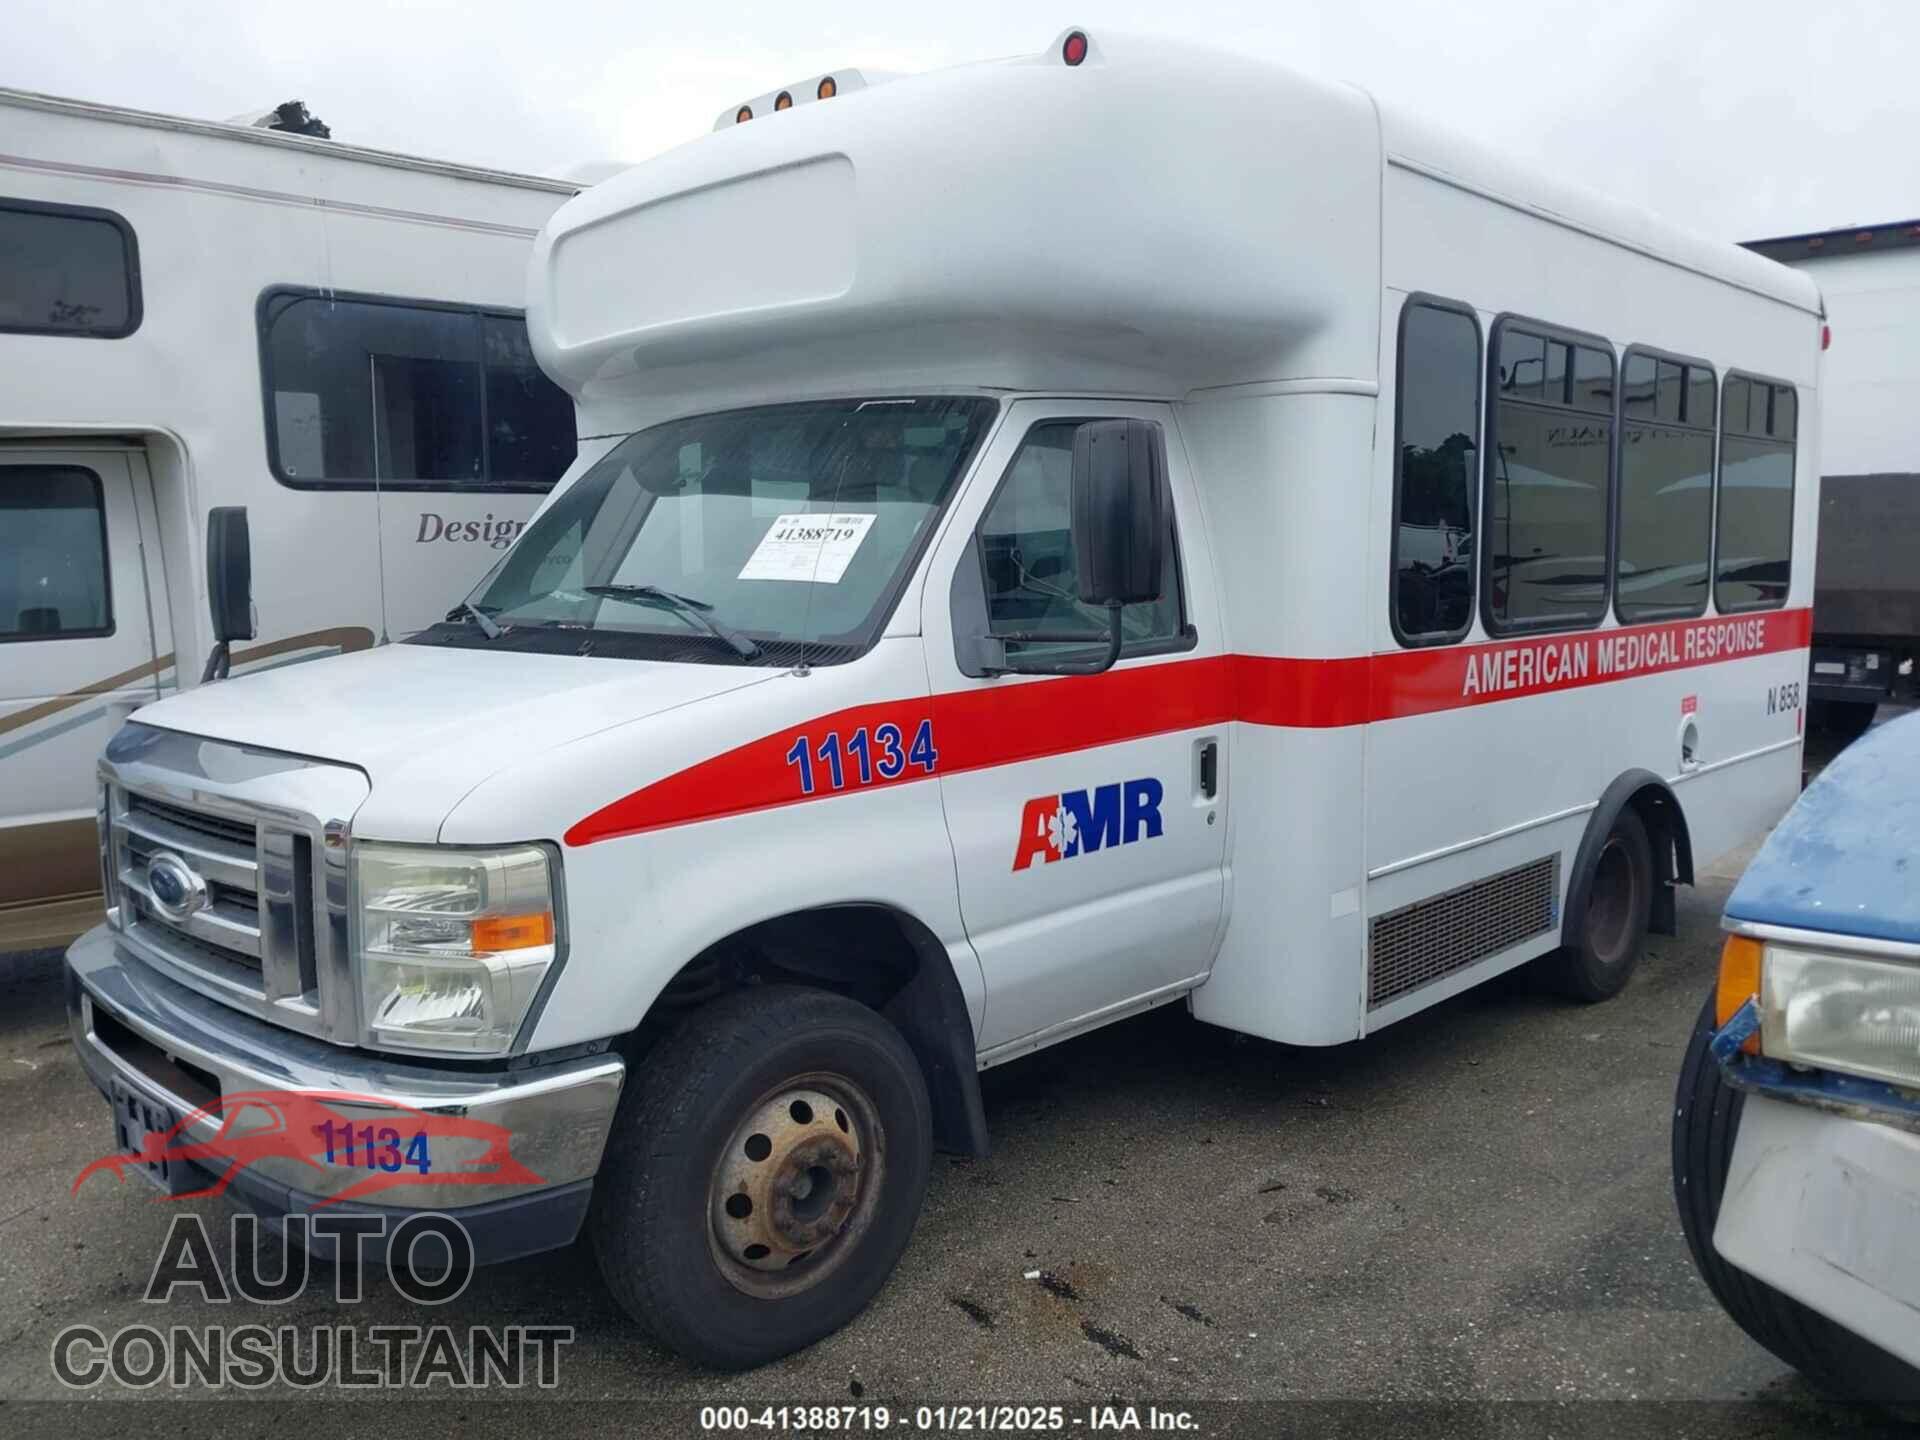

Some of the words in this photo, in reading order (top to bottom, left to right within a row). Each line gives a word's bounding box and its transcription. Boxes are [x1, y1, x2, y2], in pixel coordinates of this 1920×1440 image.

[775, 527, 855, 542] 41388719
[1463, 641, 1589, 697] AMERICAN
[1597, 630, 1680, 675] MEDICAL
[1684, 619, 1766, 661] RESPONSE
[1767, 687, 1777, 715] N
[1779, 682, 1800, 712] 858
[786, 719, 939, 794] 11134
[1012, 777, 1164, 872] AMR
[312, 1119, 432, 1175] 11134
